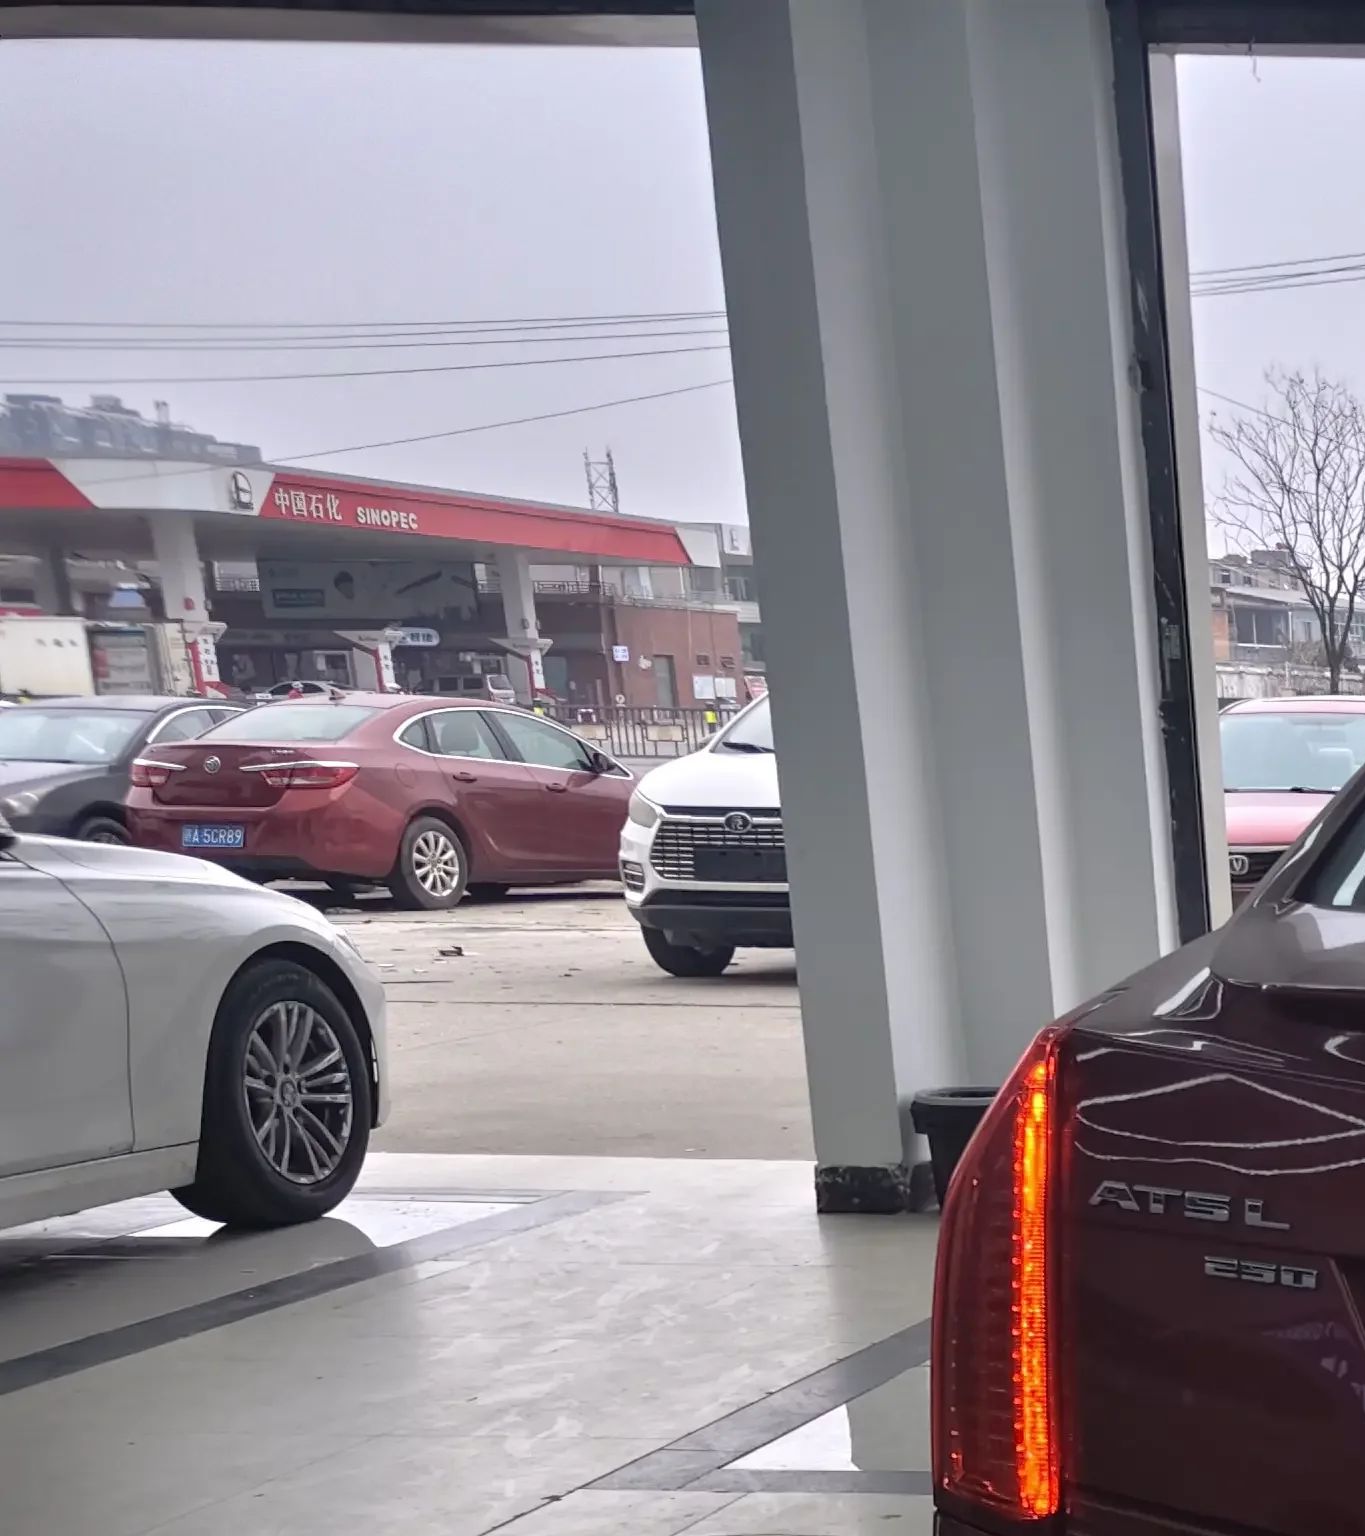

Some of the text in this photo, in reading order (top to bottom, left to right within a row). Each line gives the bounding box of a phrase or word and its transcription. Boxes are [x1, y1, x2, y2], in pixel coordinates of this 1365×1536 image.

[274, 488, 418, 530] 中国石化 SINOPEC
